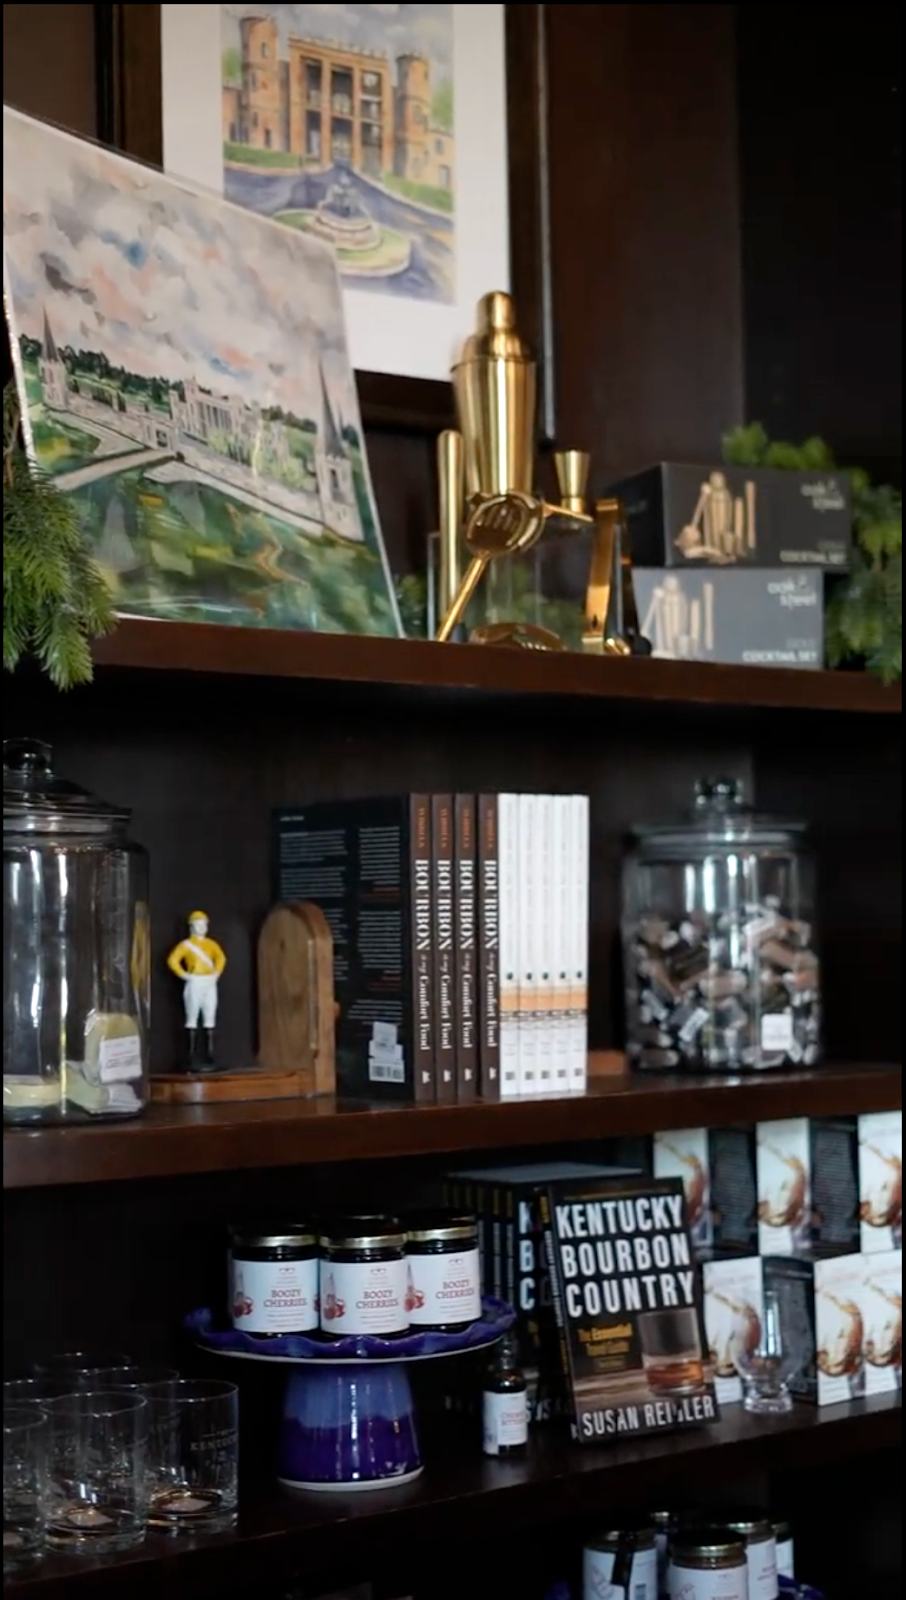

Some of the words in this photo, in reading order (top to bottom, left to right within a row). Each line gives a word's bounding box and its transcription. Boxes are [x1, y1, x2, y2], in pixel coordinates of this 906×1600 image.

[742, 650, 797, 662] COCKTAIL
[798, 651, 817, 662] SET
[415, 859, 431, 950] BOURBON
[437, 859, 453, 950] BOURBON
[460, 859, 474, 949] BOURBON
[484, 859, 498, 949] BOURBON
[419, 975, 430, 1020] Comfort
[440, 974, 452, 1019] Comfort
[462, 973, 474, 1018] Comfort
[487, 973, 498, 1017] Comfort
[420, 1023, 431, 1050] Food
[441, 1022, 453, 1050] Food
[463, 1021, 474, 1048] Food
[487, 1020, 498, 1047] Food
[555, 1194, 682, 1239] KENTUCKY
[560, 1232, 690, 1279] BOURBON
[271, 1289, 302, 1298] BOOZY
[363, 1289, 394, 1299] BOOZY
[435, 1287, 476, 1300] CHERRIES
[443, 1279, 471, 1290] BOOZY
[565, 1271, 694, 1318] COUNTRY
[263, 1298, 308, 1308] CHERRIES
[356, 1298, 399, 1309] CHERRIES
[581, 1406, 640, 1437] SUSAN
